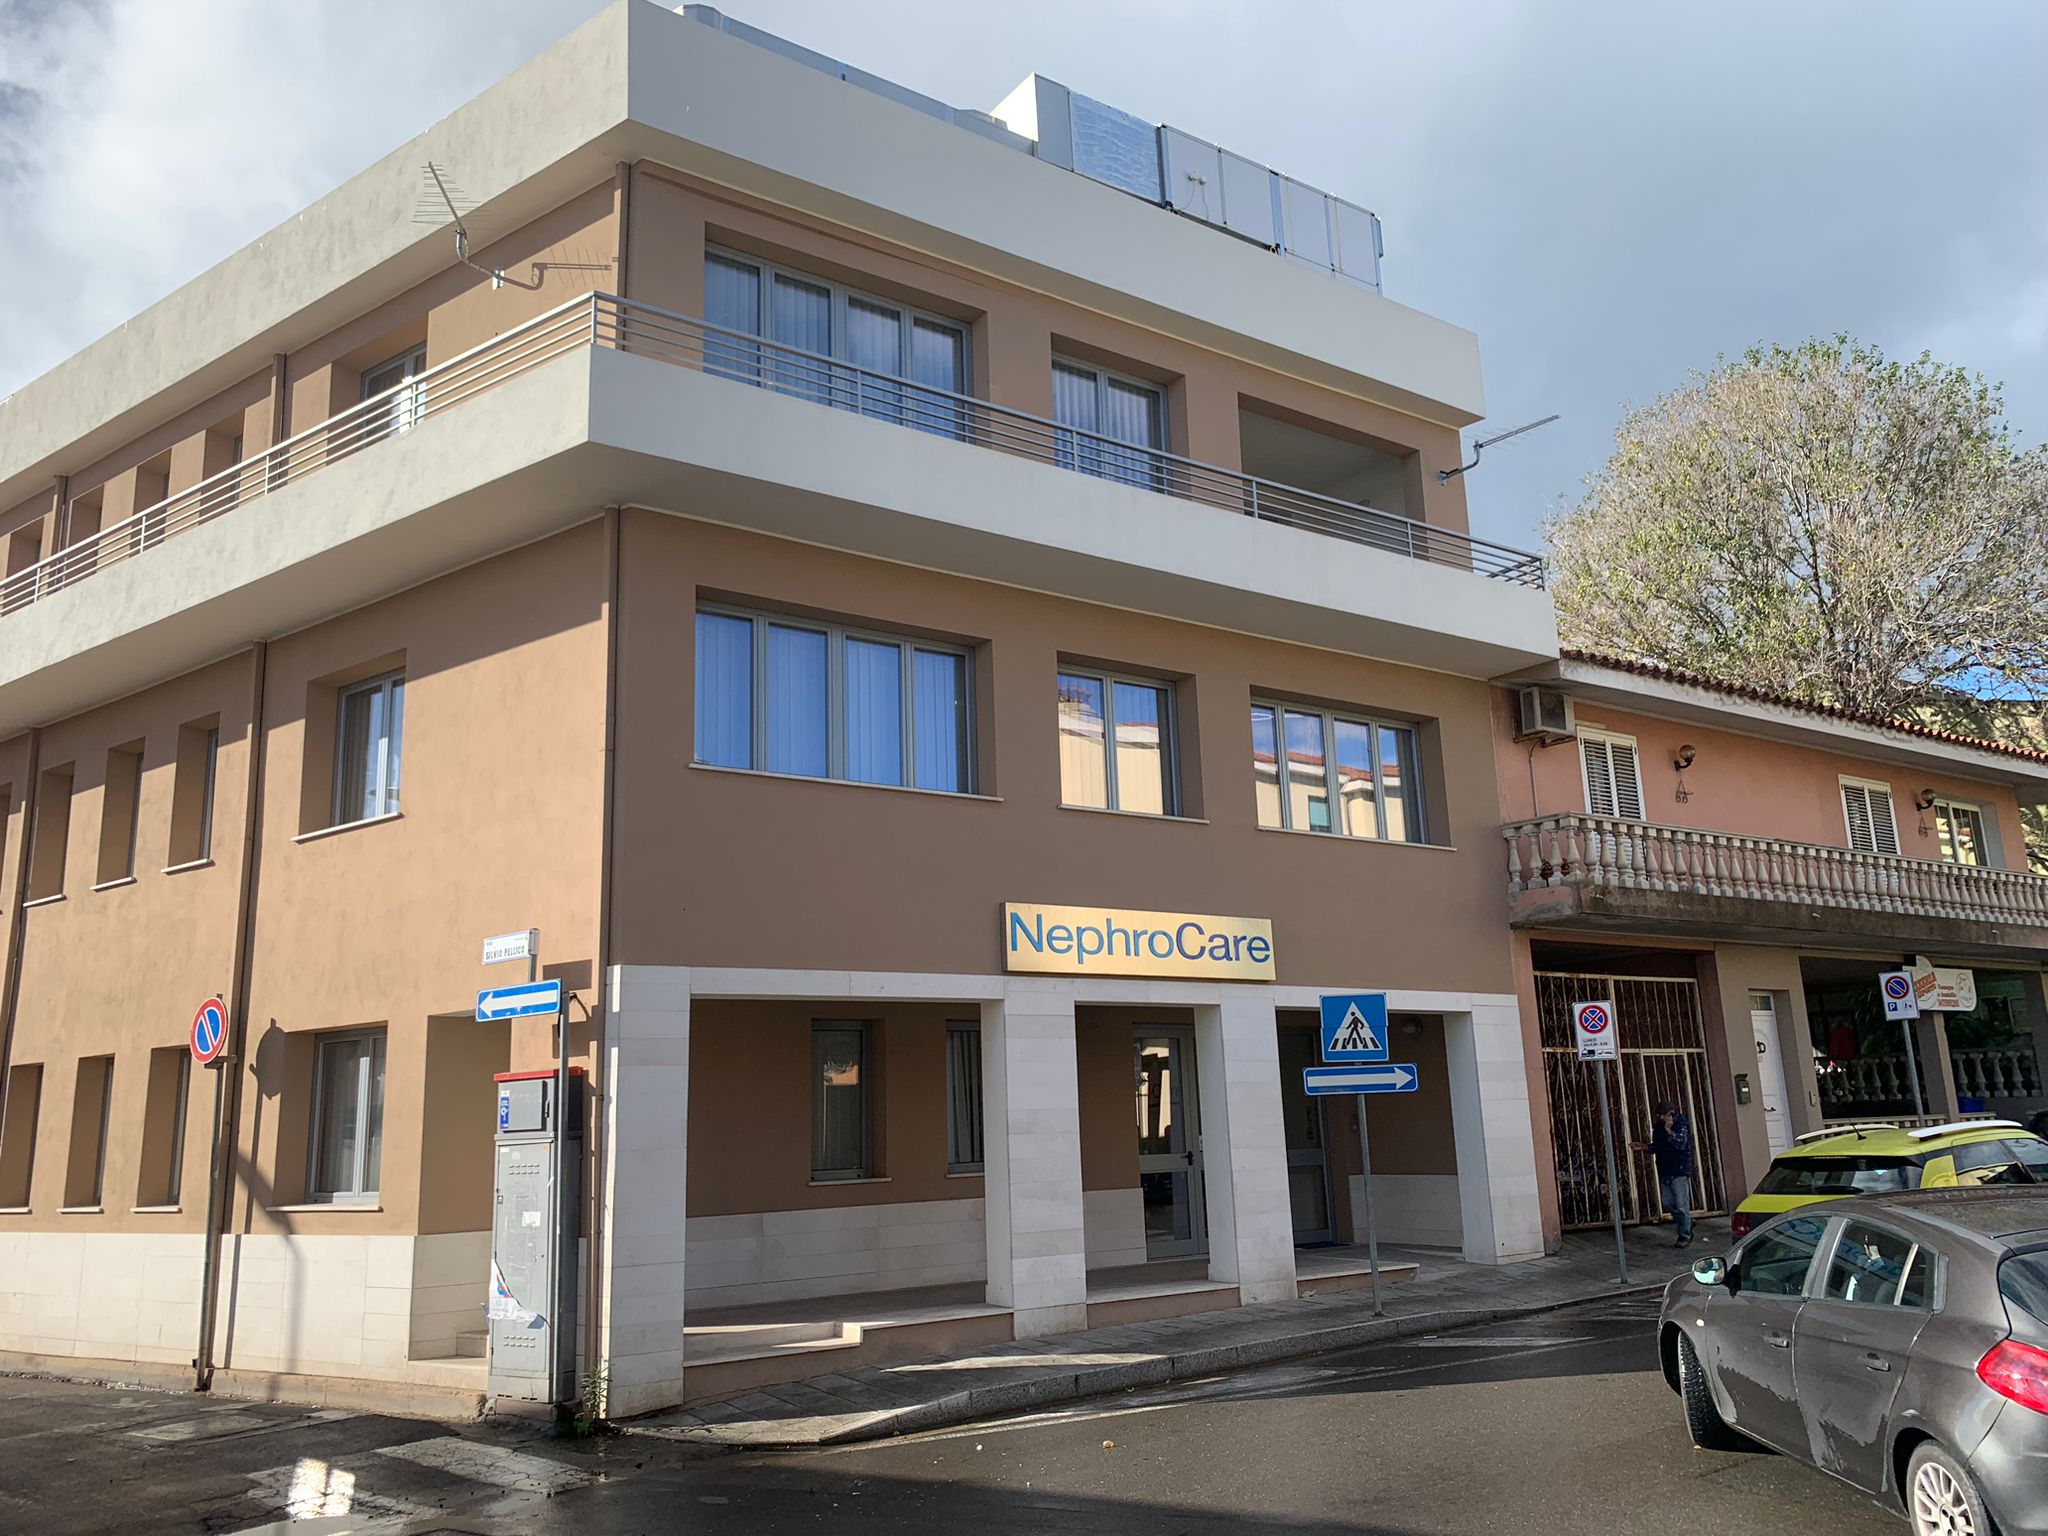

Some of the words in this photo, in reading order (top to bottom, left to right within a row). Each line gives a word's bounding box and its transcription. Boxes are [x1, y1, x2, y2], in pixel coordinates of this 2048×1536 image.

[485, 949, 503, 960] SILVIO
[504, 945, 525, 956] PELLICO
[1009, 911, 1271, 964] NephroCare
